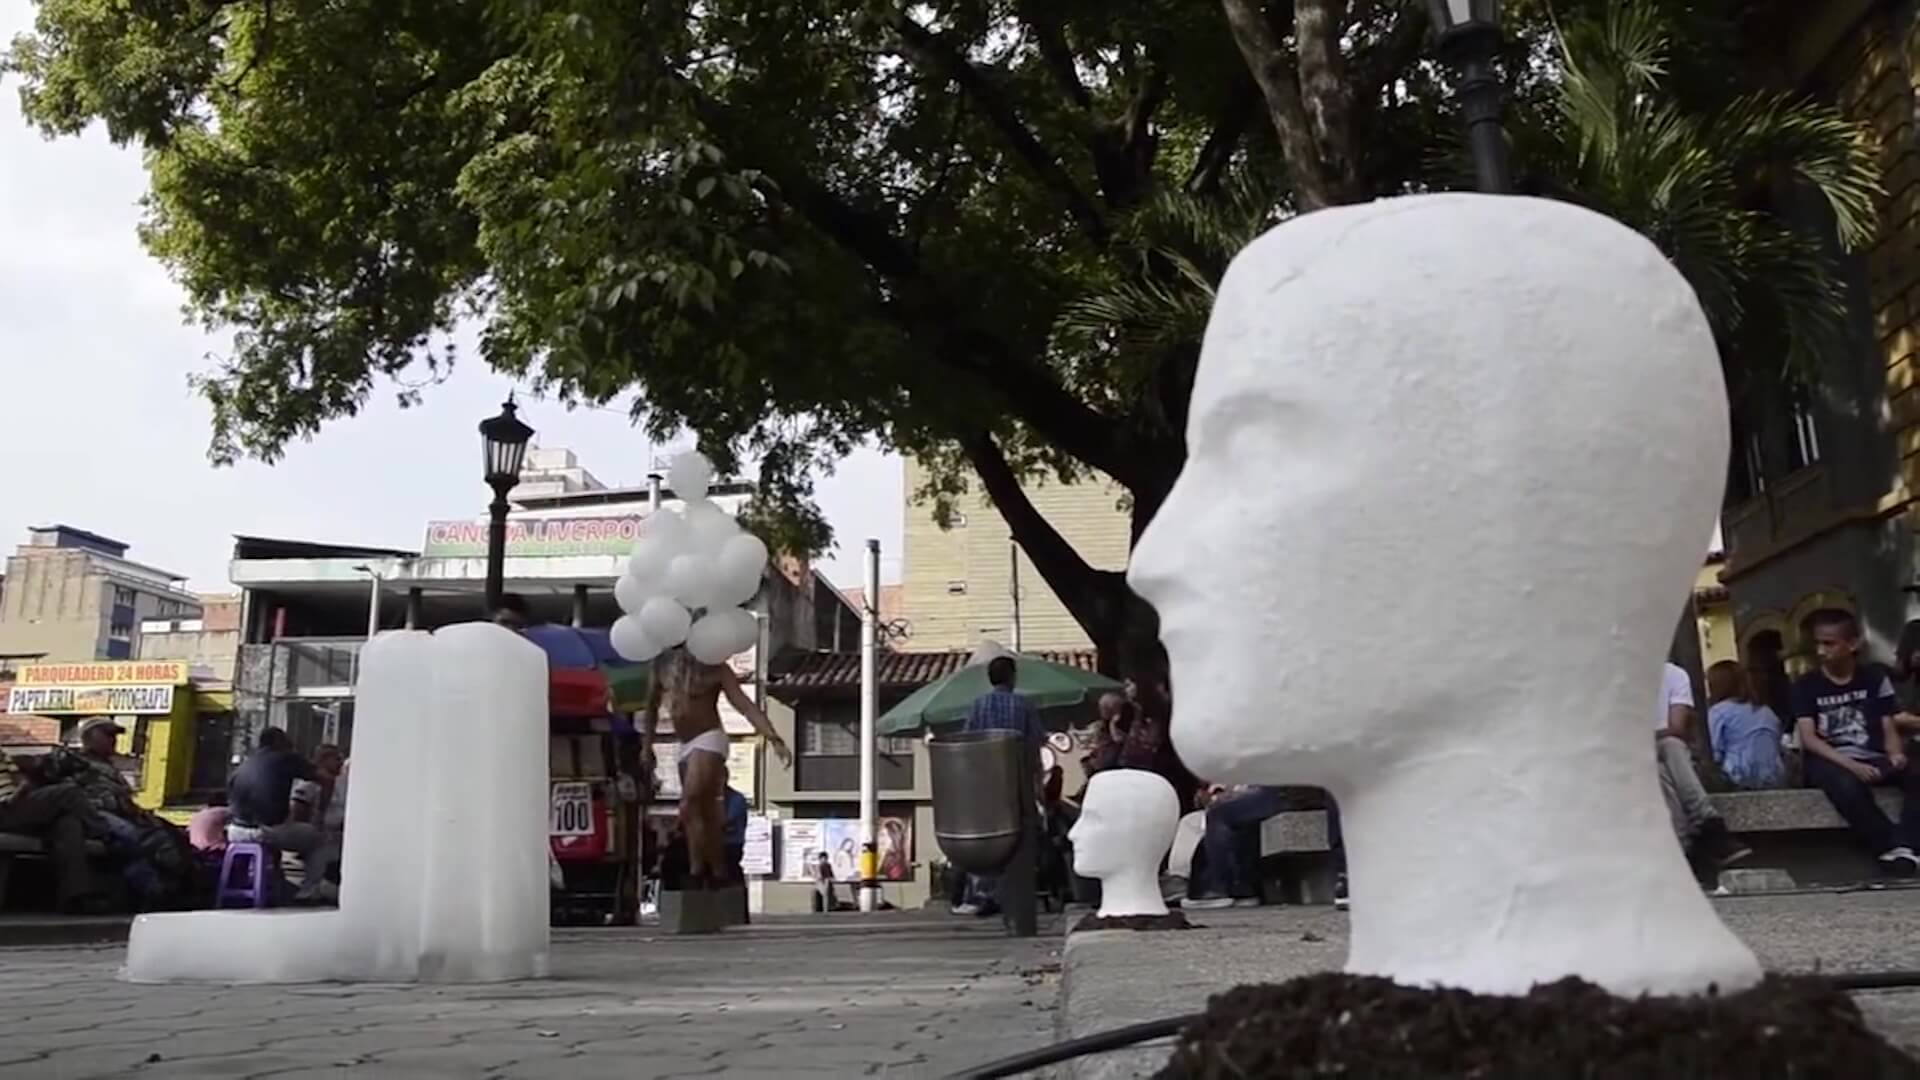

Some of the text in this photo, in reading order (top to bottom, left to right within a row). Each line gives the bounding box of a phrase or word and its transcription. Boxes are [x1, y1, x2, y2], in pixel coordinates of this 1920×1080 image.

[25, 664, 179, 683] PARQUEADERO 24 HORAS
[12, 689, 75, 711] PAPELERIA
[106, 688, 170, 711] FOTOGRAFIA
[555, 800, 589, 831] 100
